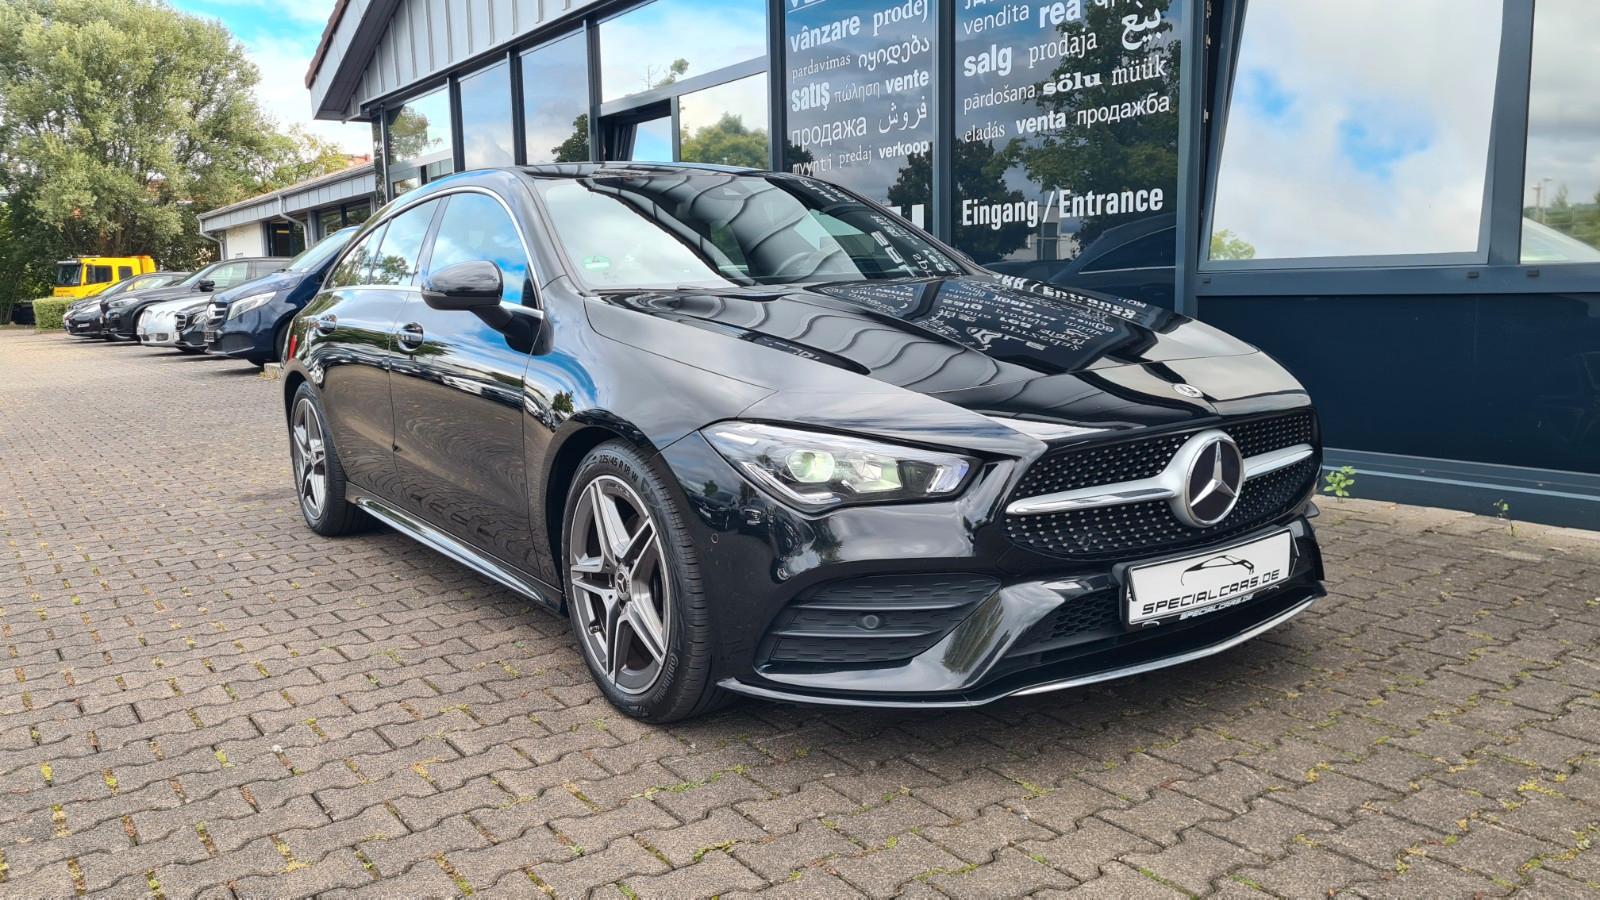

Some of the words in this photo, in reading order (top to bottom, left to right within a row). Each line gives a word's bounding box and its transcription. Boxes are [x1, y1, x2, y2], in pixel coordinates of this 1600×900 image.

[790, 15, 860, 53] vânzare
[963, 4, 1030, 35] vendita
[1040, 0, 1081, 28] rea
[1121, 7, 1162, 51] بيع
[791, 54, 851, 85] pardavimas
[858, 34, 930, 72] იყიდება
[963, 44, 1012, 77] salg
[1028, 28, 1098, 69] prodaja
[791, 82, 831, 112] satış
[833, 81, 880, 103] πώληση
[885, 69, 929, 94] vente
[964, 84, 1036, 116] pārdošana
[1042, 72, 1103, 95] sölu
[1111, 54, 1168, 86] müük
[878, 95, 928, 134] فروش
[964, 121, 1006, 143] eladás
[1016, 110, 1066, 134] venta
[1077, 91, 1170, 129] продажба
[791, 116, 867, 152] продажа
[839, 145, 872, 169] predaj
[879, 140, 929, 159] verkoop
[962, 198, 1038, 231] Eingang
[1059, 187, 1164, 219] Entrance
[1141, 569, 1281, 616] SPECIALCARS.DE
